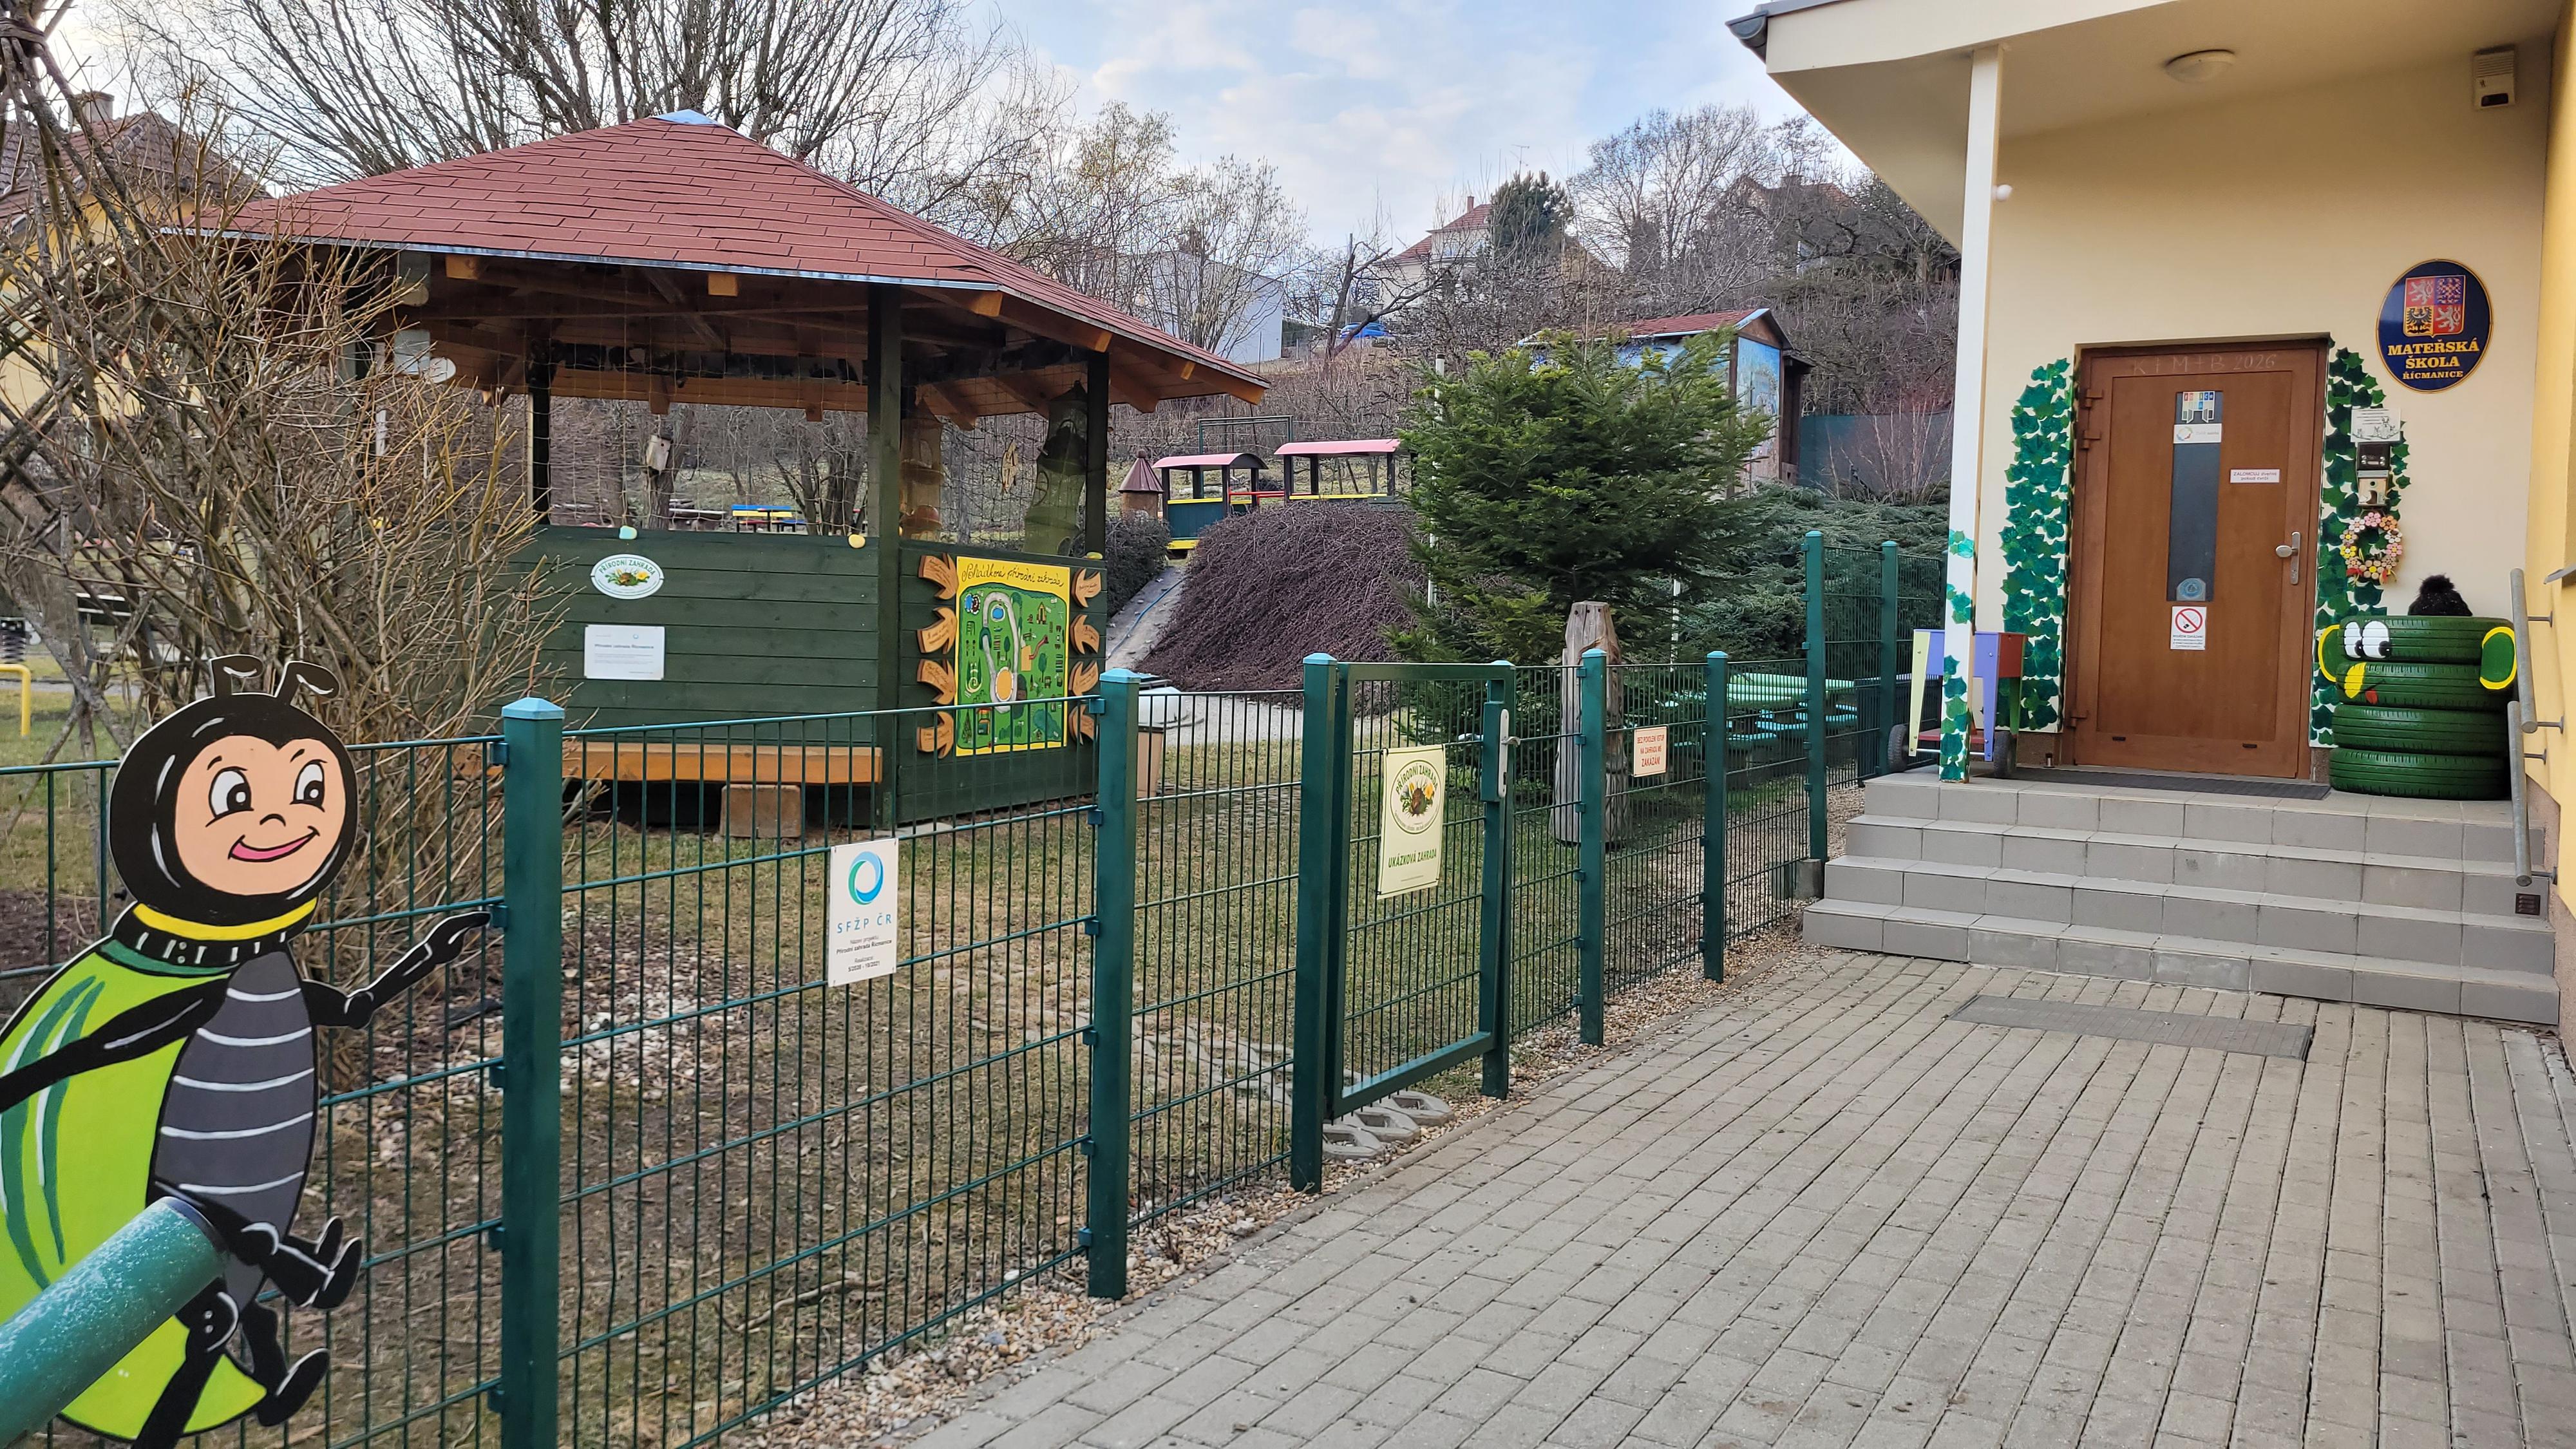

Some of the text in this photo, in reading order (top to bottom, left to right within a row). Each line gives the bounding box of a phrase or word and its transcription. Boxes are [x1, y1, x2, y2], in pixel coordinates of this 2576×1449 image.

[2387, 337, 2479, 355] MATEŘSKÁ
[2233, 354, 2277, 370] 2026
[2405, 355, 2460, 369] ŠKOLA
[2403, 370, 2464, 380] ŘÍCMANICE
[599, 559, 656, 575] PŘÍRODNÍ ZAHRADA
[1396, 762, 1438, 795] PŘÍRODNÍ ZAHRADA
[1388, 848, 1436, 868] UKÁZKOVÁ ZAHRADA
[837, 913, 891, 934] SFŽP ČR
